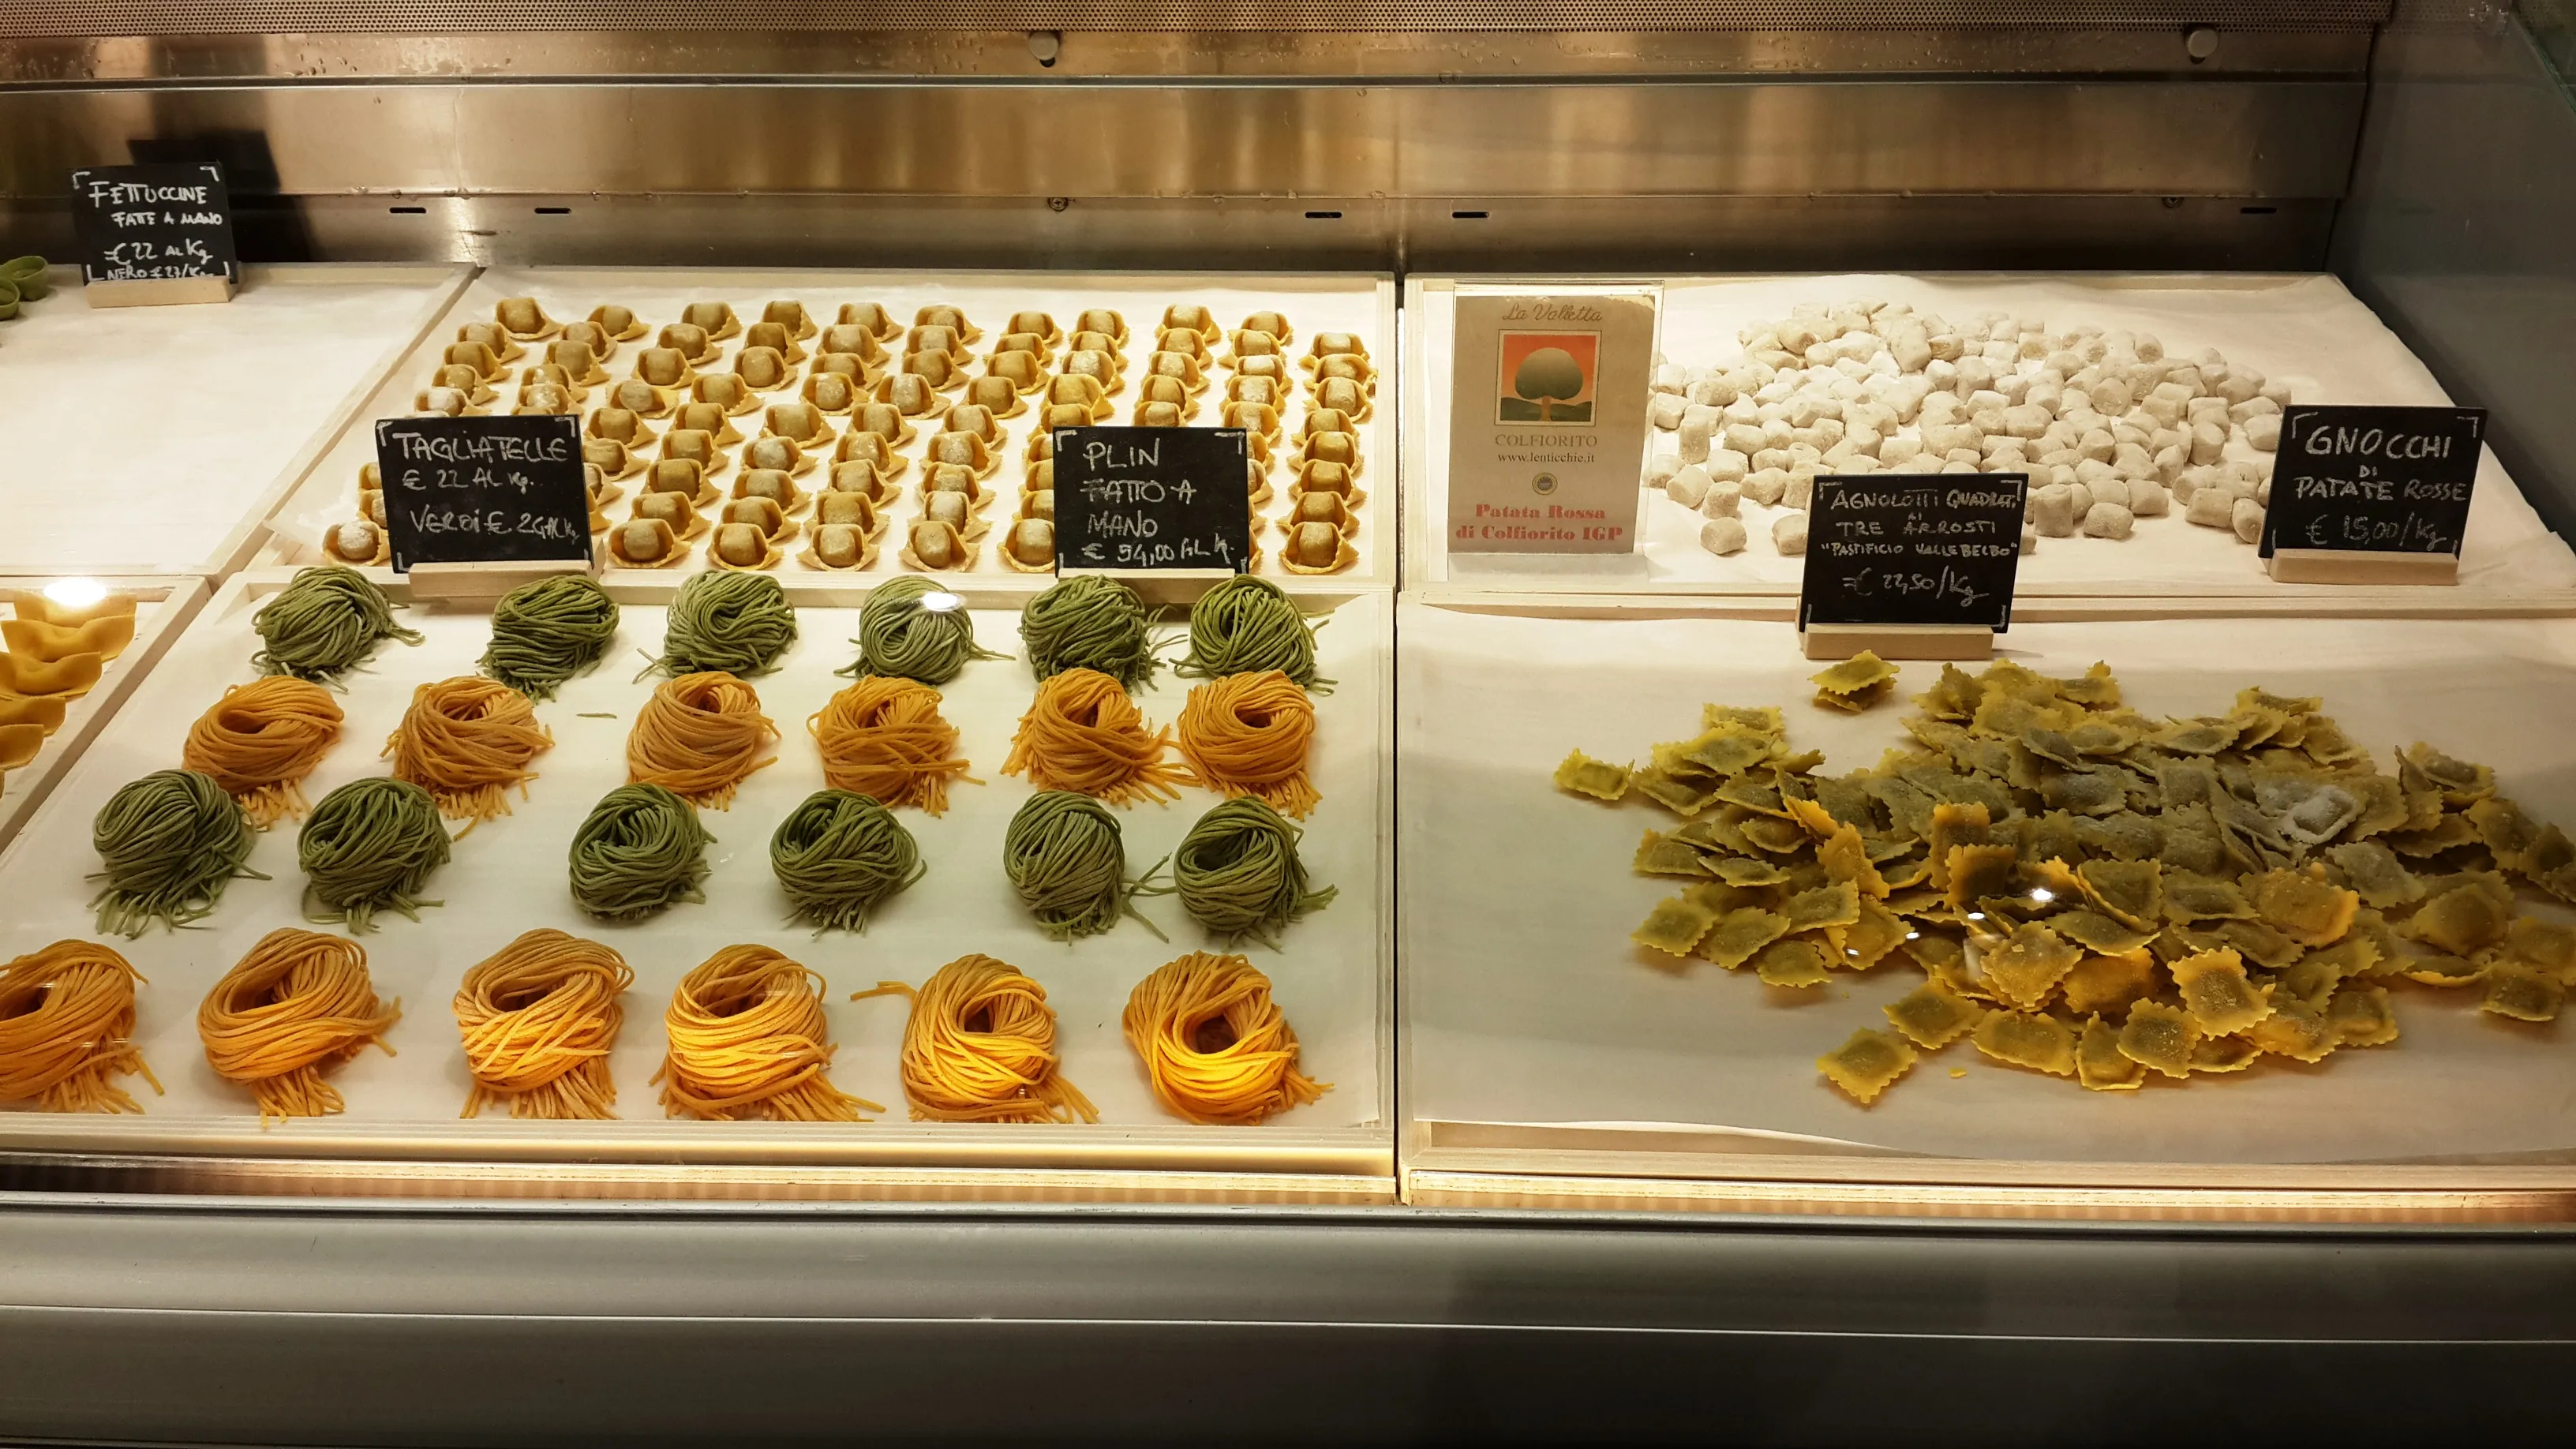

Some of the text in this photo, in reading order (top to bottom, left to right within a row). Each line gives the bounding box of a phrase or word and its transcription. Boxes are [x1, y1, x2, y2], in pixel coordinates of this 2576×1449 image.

[88, 181, 208, 208] FETTUCCINE
[110, 211, 223, 228] FATTE A MANO
[107, 265, 148, 280] NERO
[1502, 303, 1603, 321] La Valletta
[391, 430, 568, 464] TAGLIATELLE
[1494, 433, 1599, 448] COLFIORITO
[2305, 425, 2452, 459] GNOCCHI
[1082, 437, 1161, 471] PLIN
[1497, 452, 1595, 463] www.lenticchie.it
[402, 470, 427, 491] €
[436, 469, 468, 489] 22
[472, 467, 503, 489] AL
[2358, 464, 2379, 478] DI
[1079, 478, 1197, 504] FATTO A
[2293, 475, 2468, 501] PATATE ROSSE
[1830, 489, 1939, 511] AGNOLOTTI
[410, 504, 481, 534] VERDI
[483, 511, 513, 536] €
[1475, 504, 1606, 520] Patata Rossa
[1087, 510, 1159, 538] MANO
[1455, 525, 1623, 541] di Colfiorito IGP
[1835, 519, 1996, 537] TRE ARROSTI
[2305, 514, 2328, 545] €
[1081, 542, 1106, 560] €
[1180, 537, 1211, 560] AL
[1841, 567, 1874, 597] €
